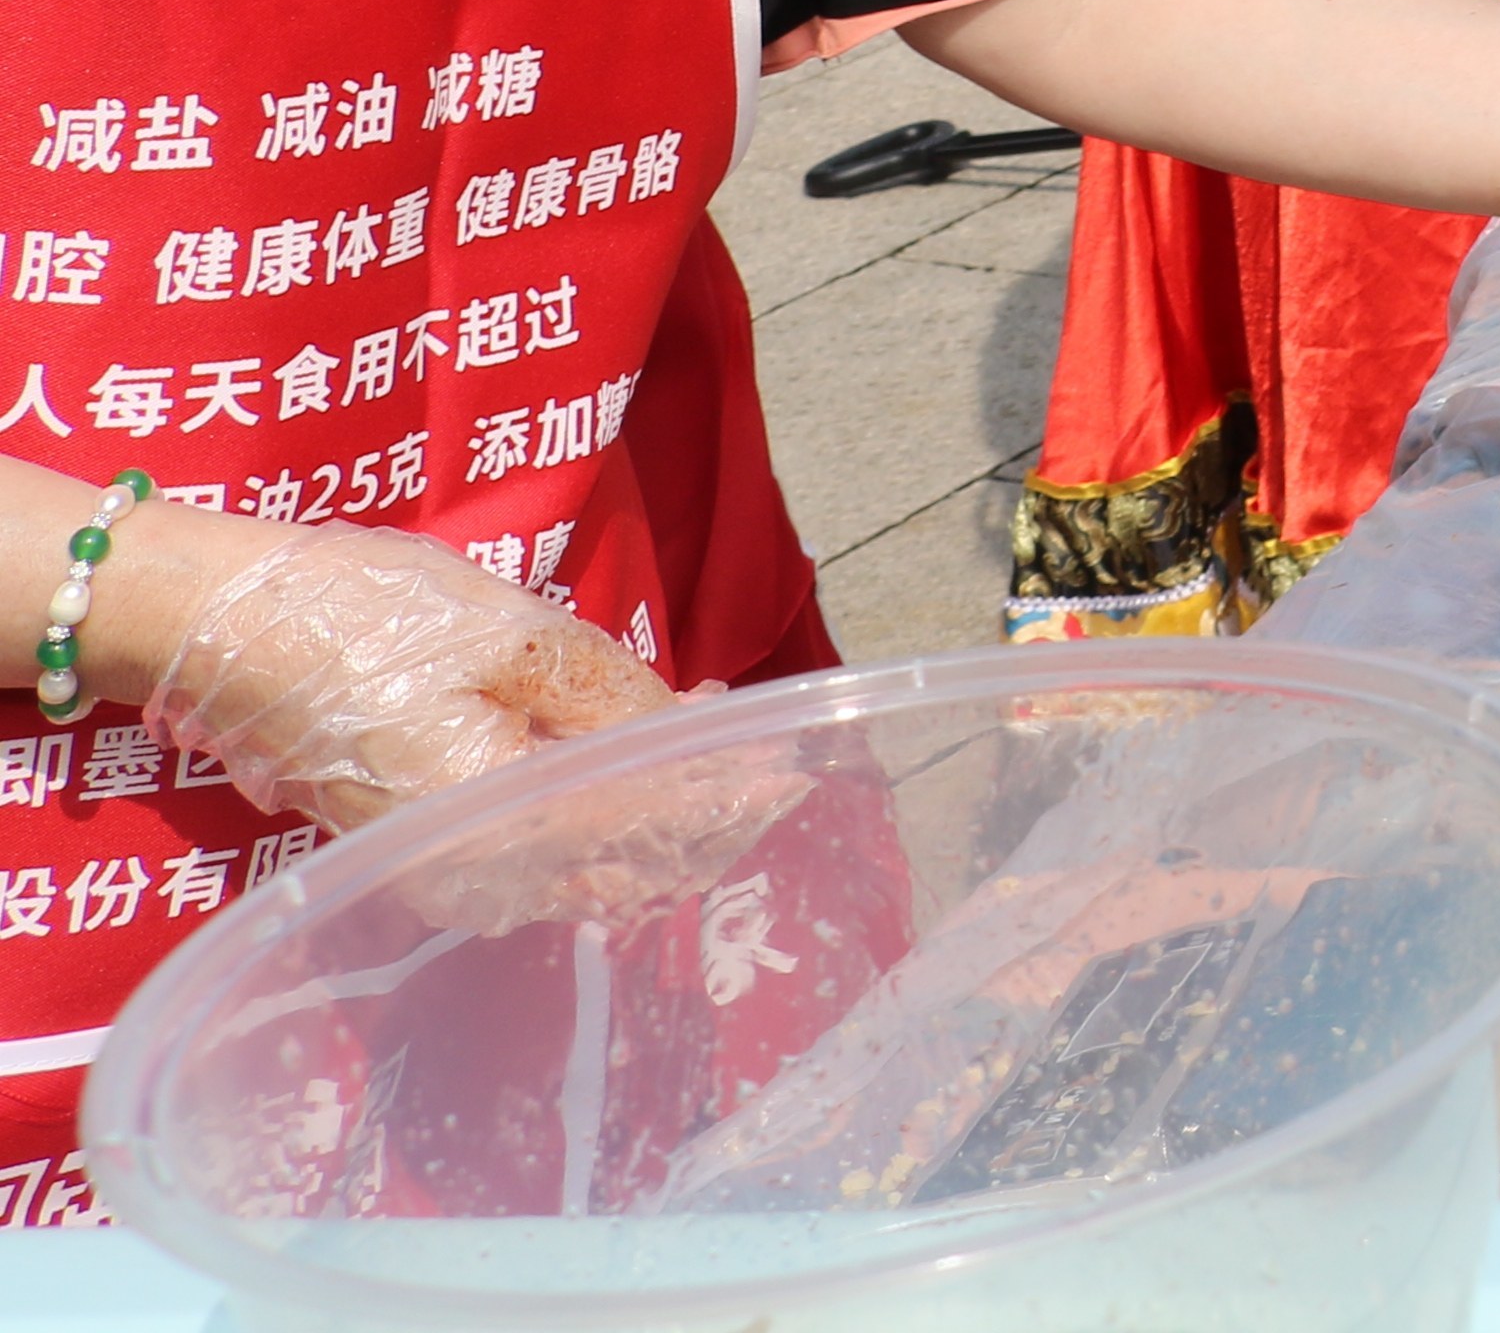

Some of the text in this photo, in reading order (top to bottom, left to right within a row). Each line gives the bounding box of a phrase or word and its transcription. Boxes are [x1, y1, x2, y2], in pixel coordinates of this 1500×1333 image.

[30, 43, 545, 175] 减盐 减油 减糖
[0, 129, 682, 307] 腔 健康体重 健康骨骼
[0, 276, 580, 439] 人每天食用不超过
